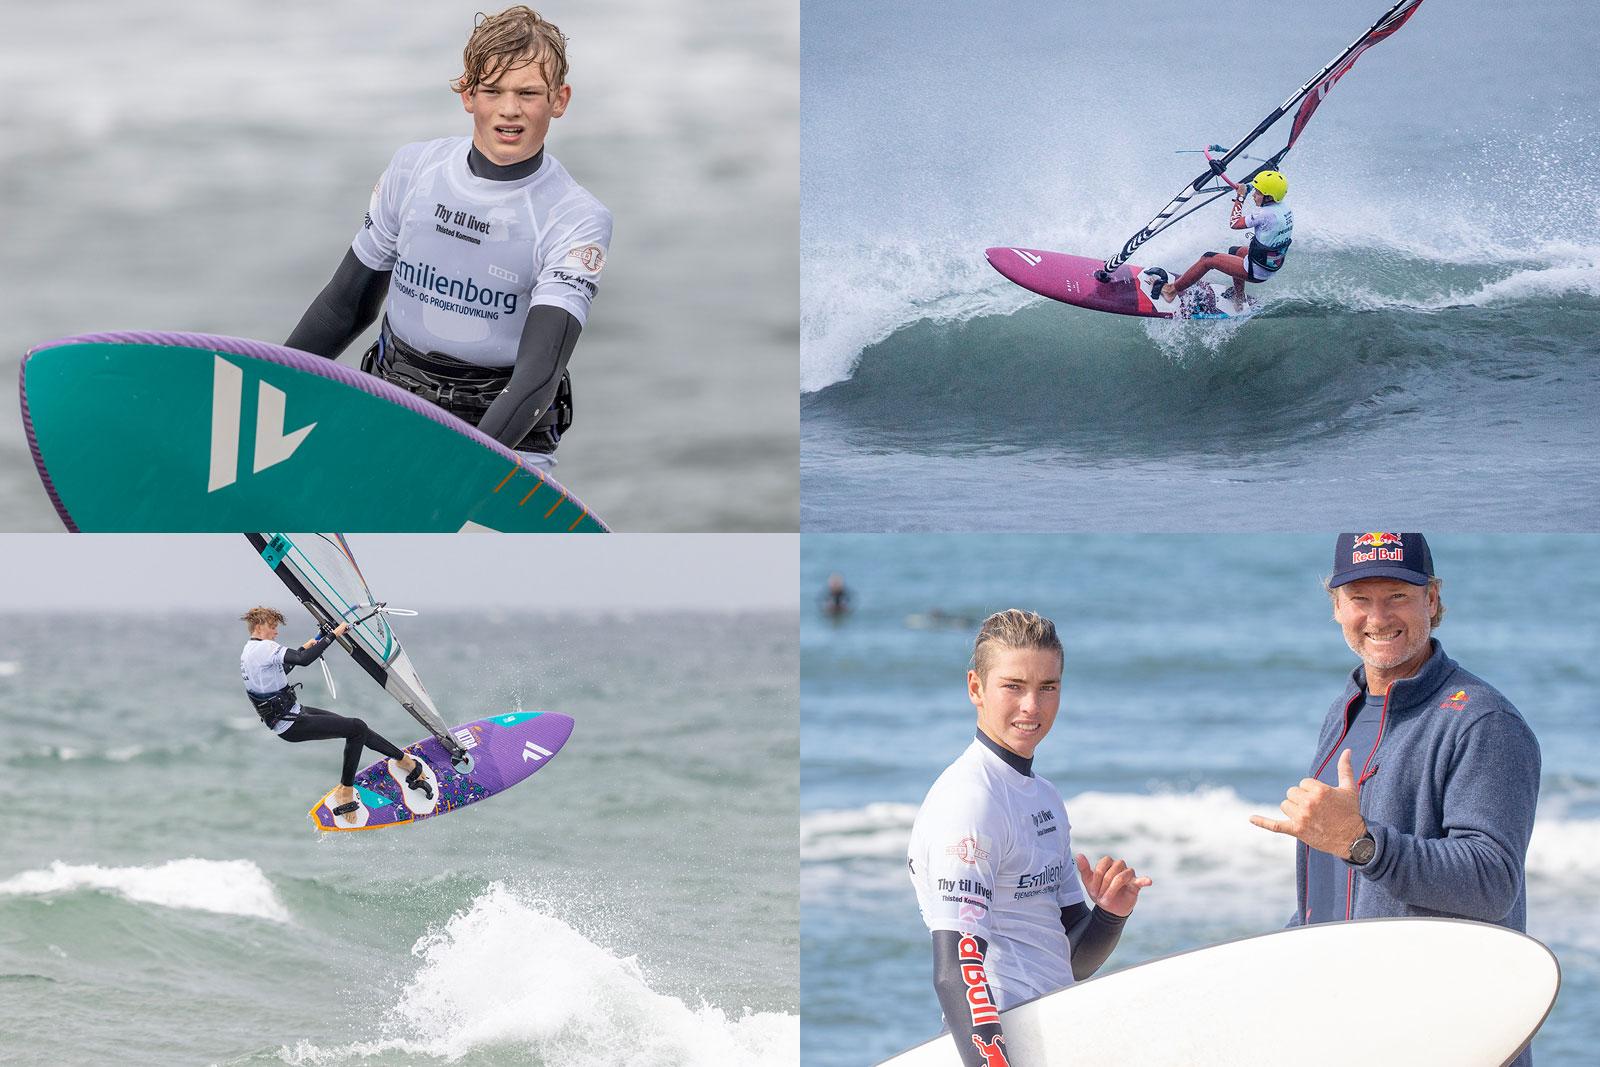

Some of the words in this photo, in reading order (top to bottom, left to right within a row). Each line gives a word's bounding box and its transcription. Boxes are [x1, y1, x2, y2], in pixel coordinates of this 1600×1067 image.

[434, 203, 453, 223] Thy
[453, 211, 467, 226] til
[467, 215, 491, 235] livet
[419, 292, 429, 303] OG
[430, 296, 499, 320] PROJEKTUDVIKLING
[1353, 548, 1376, 564] Red
[1379, 548, 1403, 561] Bull
[938, 878, 956, 892] Thy
[959, 879, 971, 892] til
[975, 882, 992, 902] livet
[942, 895, 963, 903] Thisted
[961, 964, 1000, 1026] Bull
